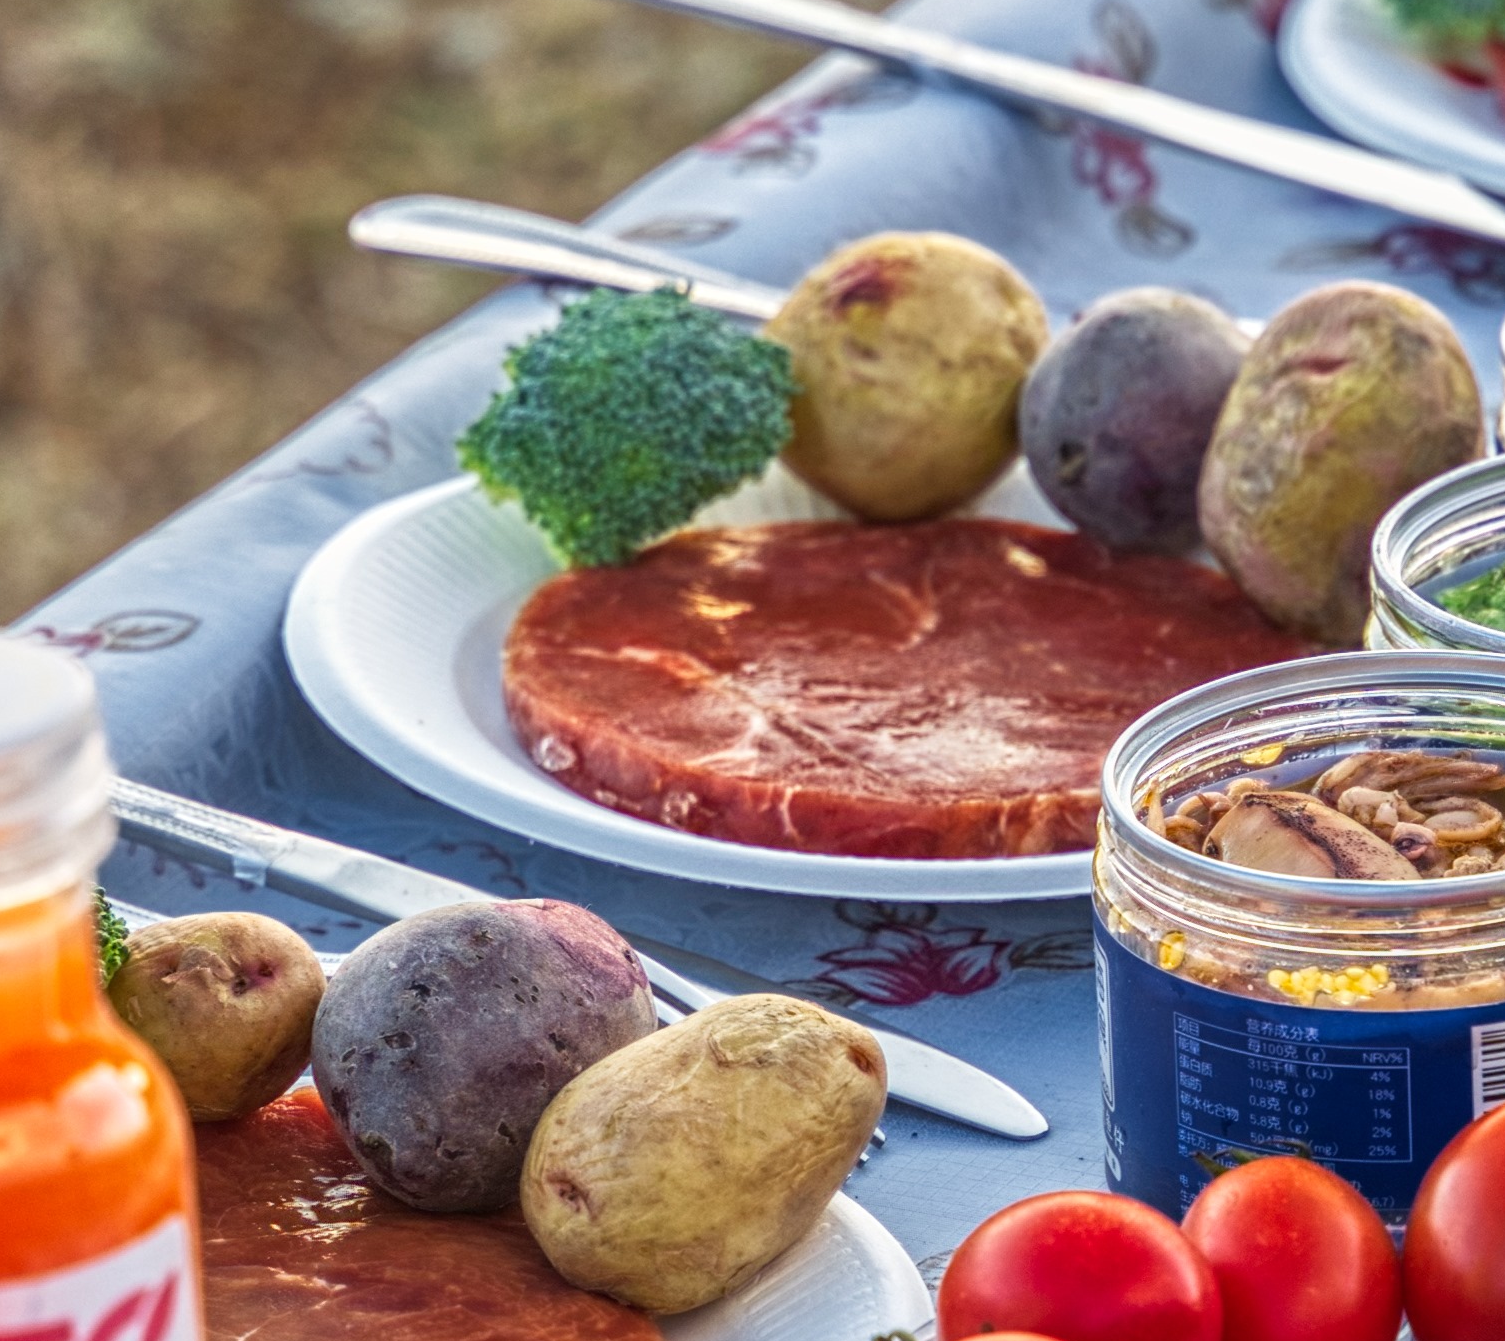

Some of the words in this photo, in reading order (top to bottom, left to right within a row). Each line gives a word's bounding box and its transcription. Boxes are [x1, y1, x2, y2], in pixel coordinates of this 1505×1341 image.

[1177, 1017, 1200, 1036] 项目
[1362, 1052, 1403, 1064] NRV%
[1246, 1019, 1319, 1042] 营养成分表
[1178, 1036, 1200, 1056] 能量
[1370, 1071, 1391, 1083] 4%
[1178, 1055, 1213, 1078] 蛋白质
[1368, 1089, 1395, 1101] 18%
[1179, 1072, 1202, 1092] 脂肪
[1373, 1108, 1391, 1120] 1%
[1180, 1090, 1239, 1122] 碳水化合物
[1372, 1127, 1392, 1139] 2%
[1181, 1110, 1193, 1125] 钠
[1368, 1145, 1397, 1156] 25%
